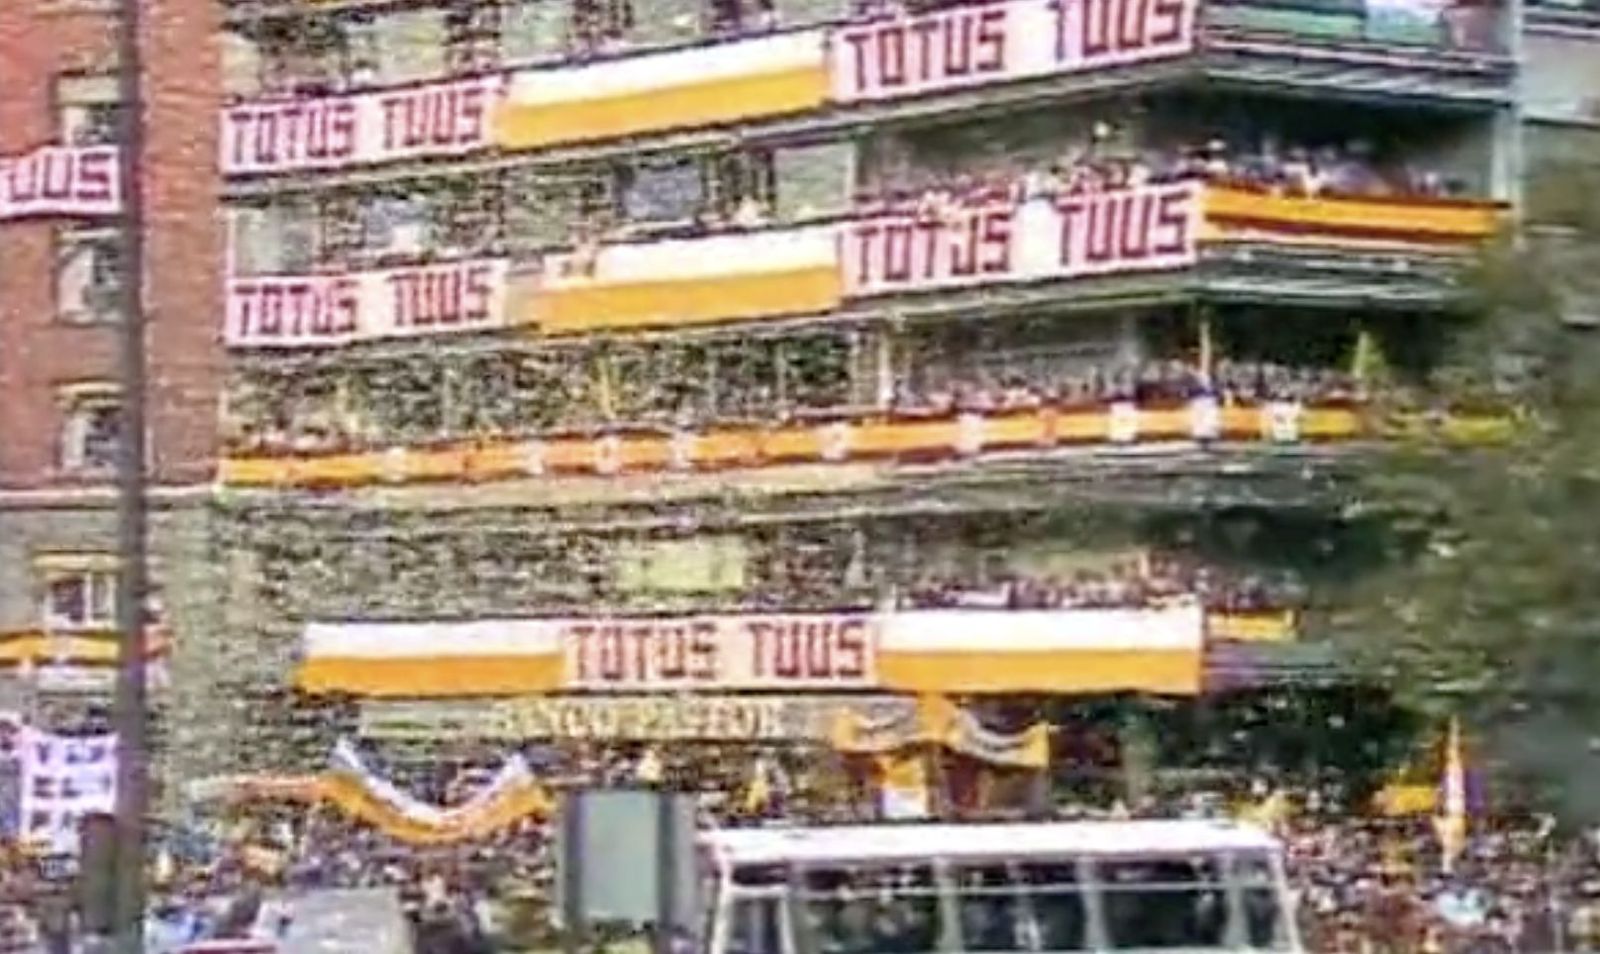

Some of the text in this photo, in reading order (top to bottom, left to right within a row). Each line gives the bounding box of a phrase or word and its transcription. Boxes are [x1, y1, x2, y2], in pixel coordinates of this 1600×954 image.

[843, 0, 1184, 91] TOTUS TUUS
[230, 88, 483, 164] TOTUS TUUS
[853, 191, 1188, 284] TOTUS TUUS
[234, 267, 490, 335] TOTUS TUUS
[571, 622, 864, 681] TOTUS TUUS
